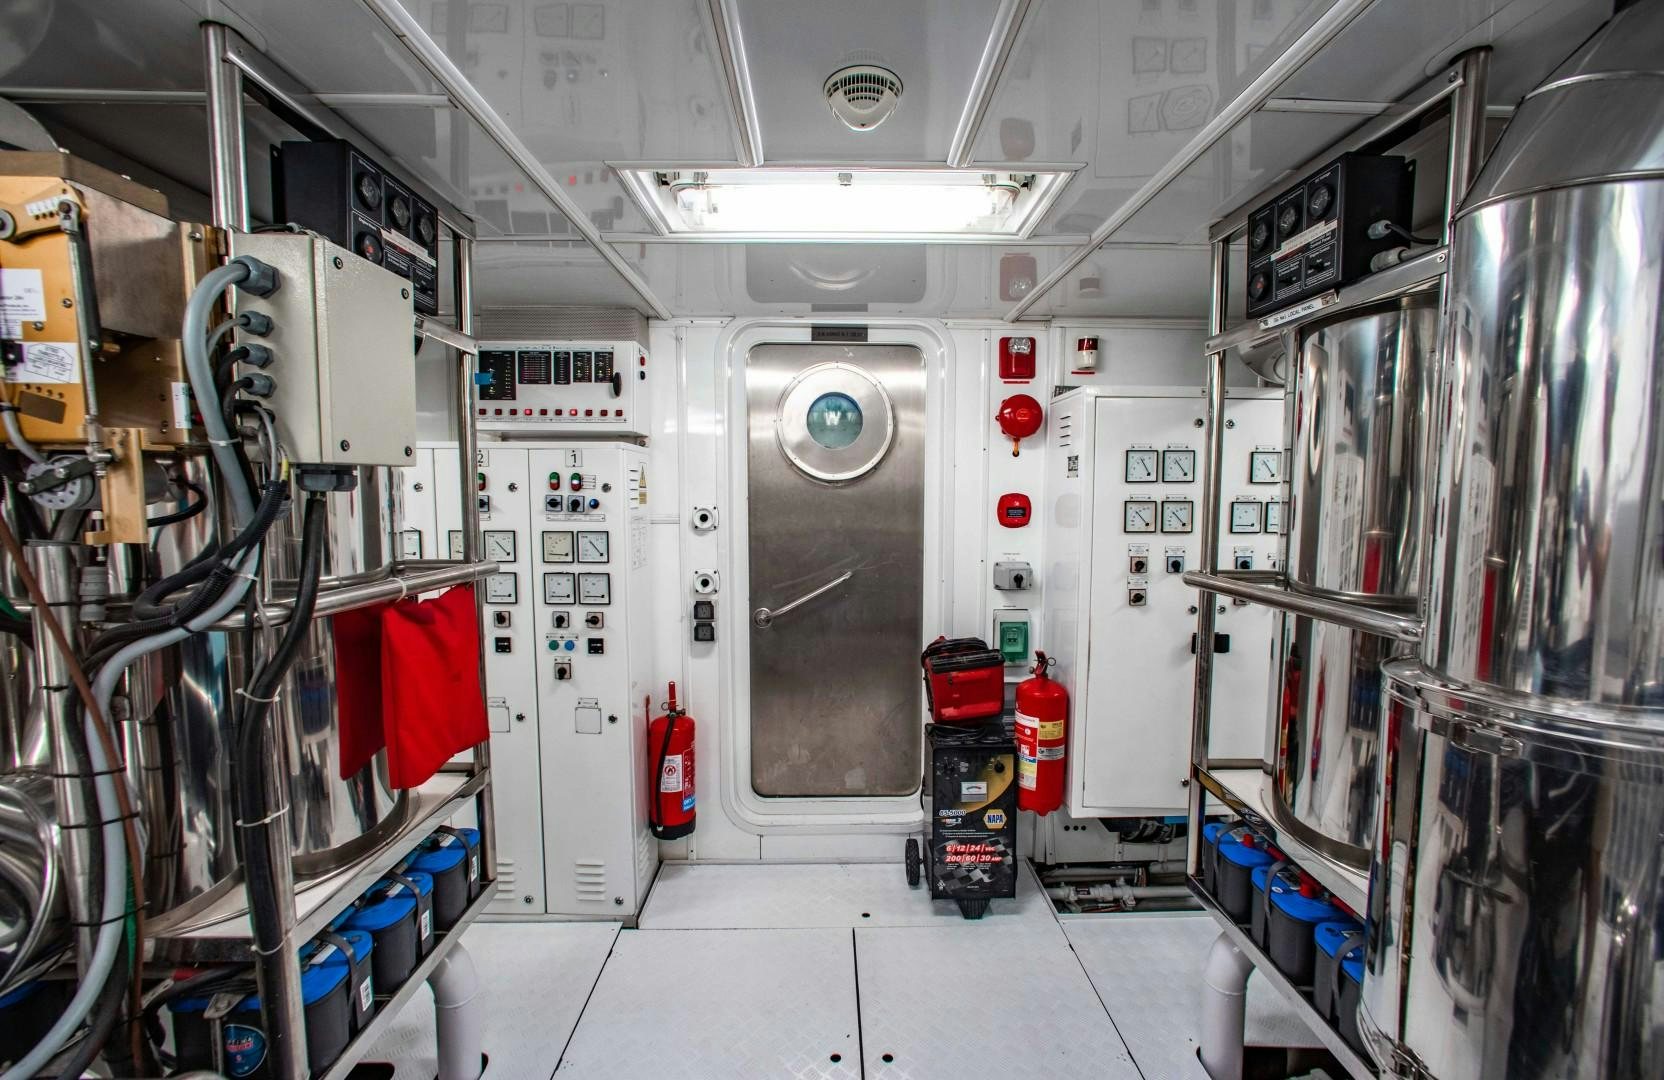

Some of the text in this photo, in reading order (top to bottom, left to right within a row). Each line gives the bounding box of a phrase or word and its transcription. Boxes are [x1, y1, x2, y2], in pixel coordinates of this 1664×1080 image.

[1288, 309, 1300, 318] LOCAL
[570, 453, 577, 463] 1
[987, 814, 1004, 823] NAPA
